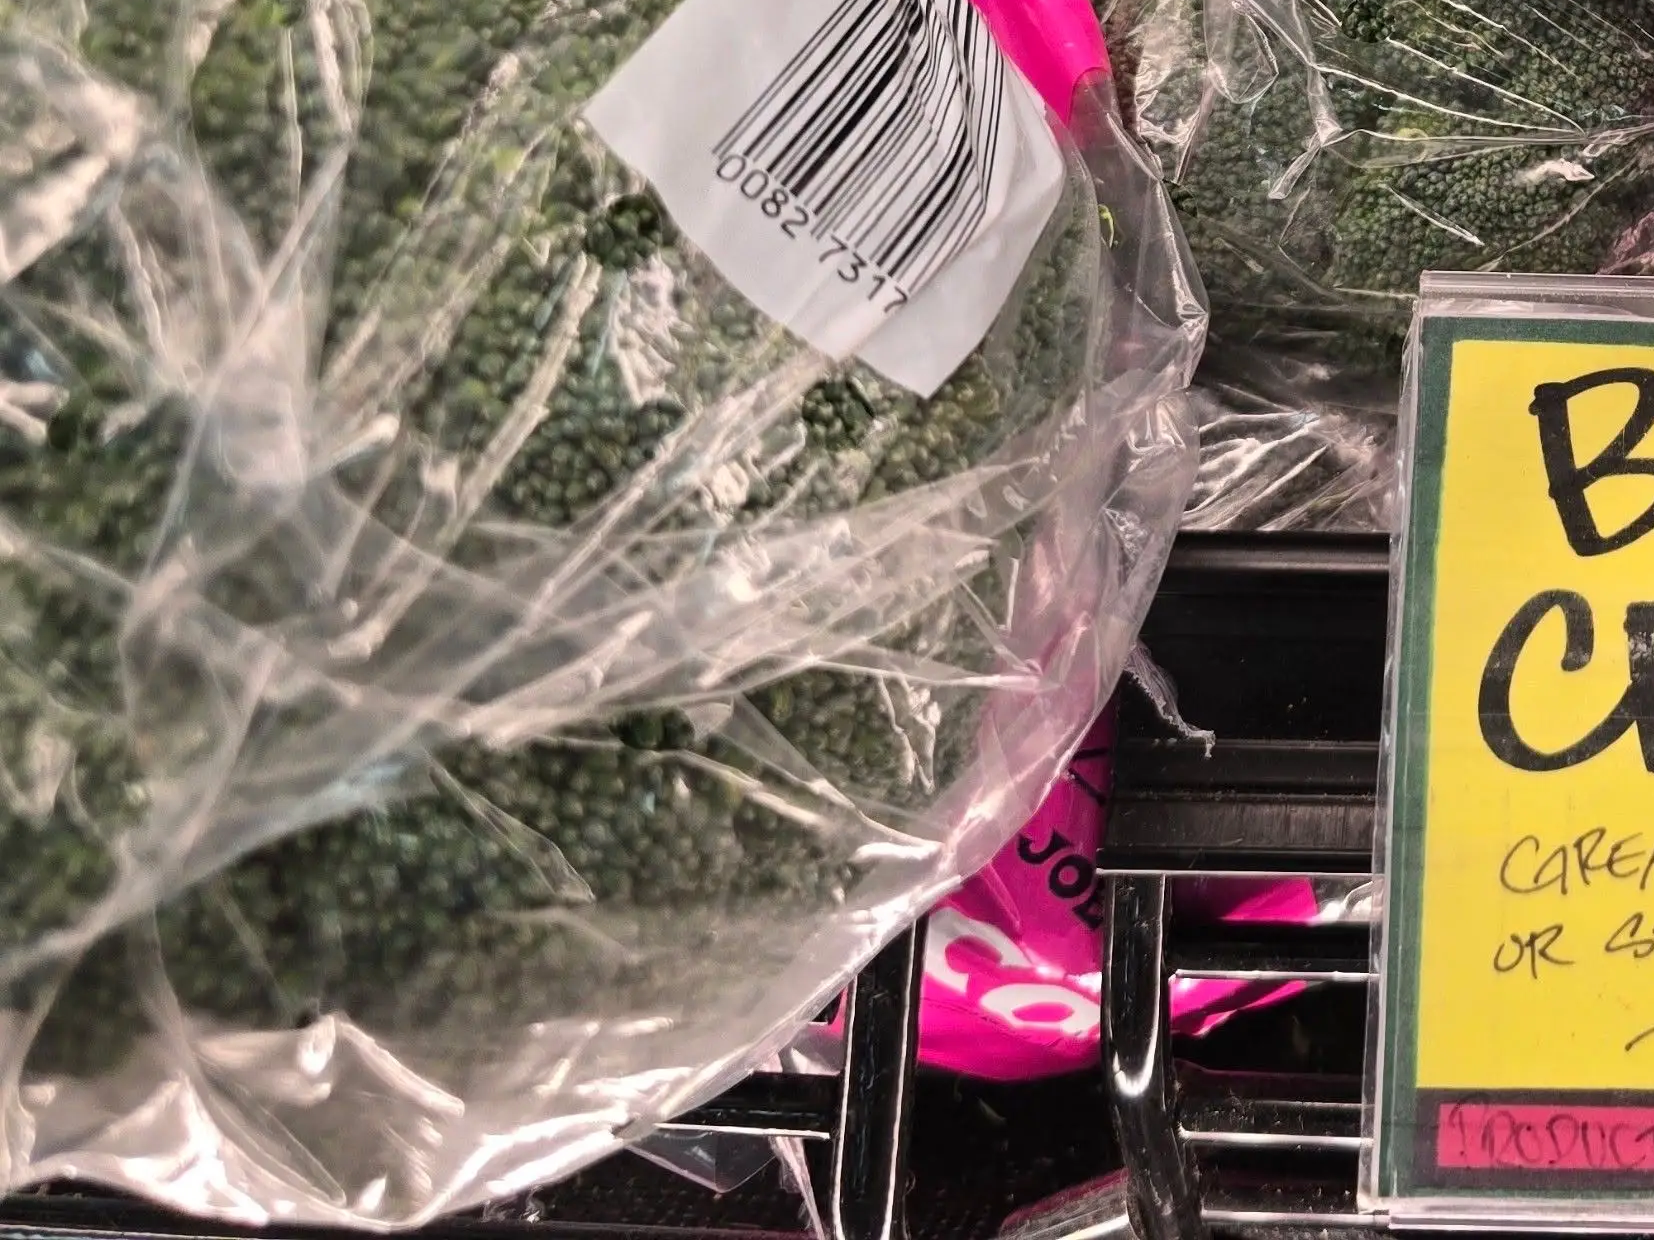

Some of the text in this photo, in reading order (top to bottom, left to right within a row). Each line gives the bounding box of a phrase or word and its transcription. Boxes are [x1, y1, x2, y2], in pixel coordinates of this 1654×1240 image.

[715, 152, 909, 313] 0082 7317
[1493, 924, 1575, 979] OR
